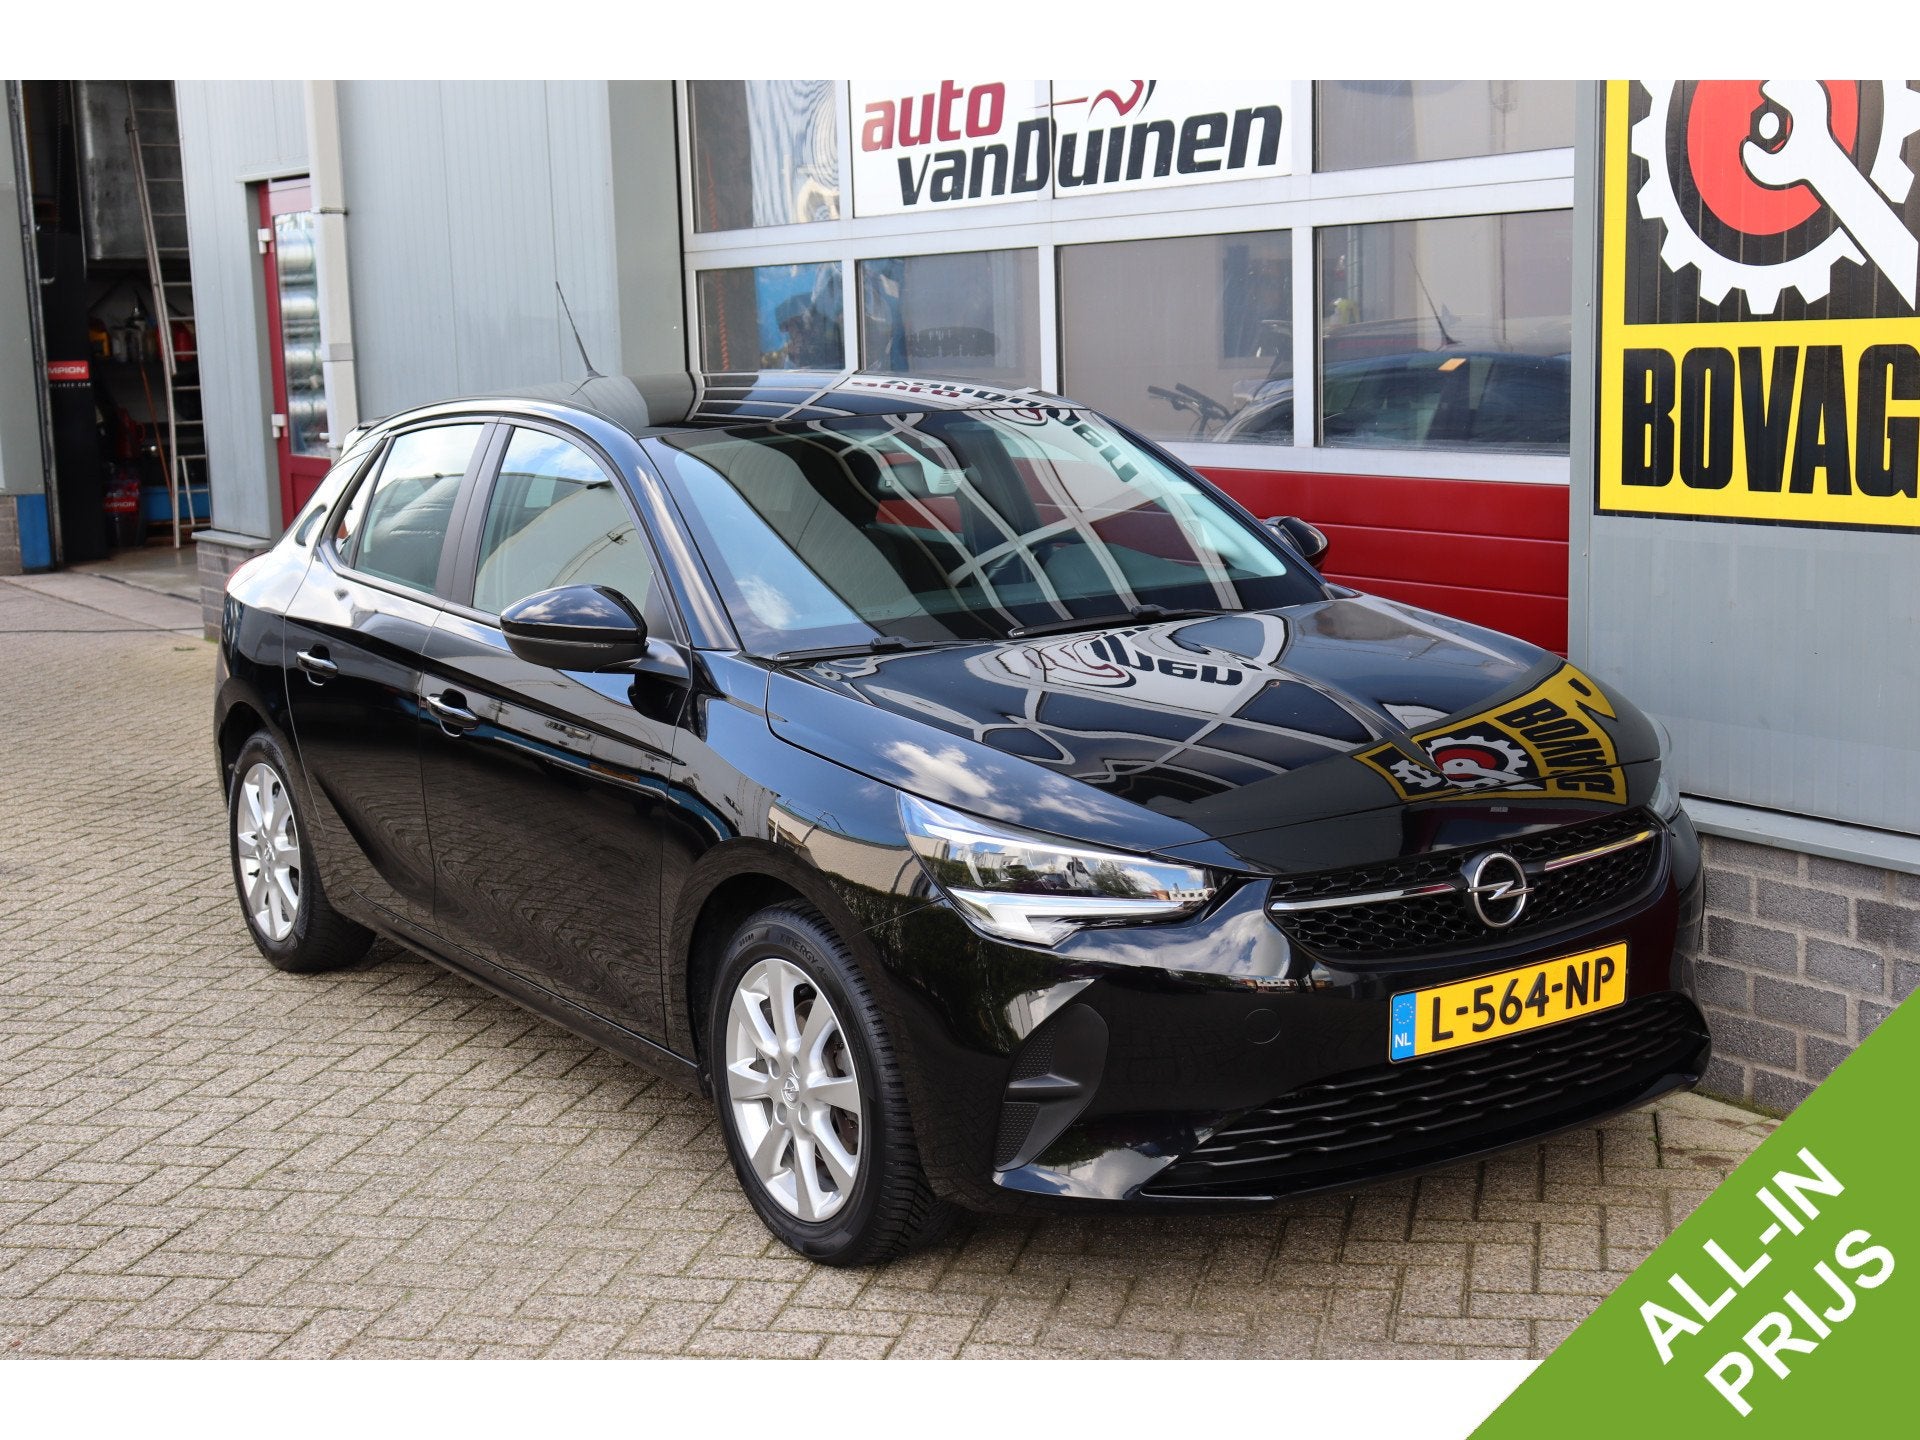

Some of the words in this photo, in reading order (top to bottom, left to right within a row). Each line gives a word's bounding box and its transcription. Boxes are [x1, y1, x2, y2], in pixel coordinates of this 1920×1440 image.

[861, 80, 1005, 152] auto
[897, 104, 1282, 206] vanDuinen
[1622, 344, 1919, 498] BOVAG
[1394, 1032, 1412, 1048] NL
[1431, 956, 1615, 1043] L-564-NP
